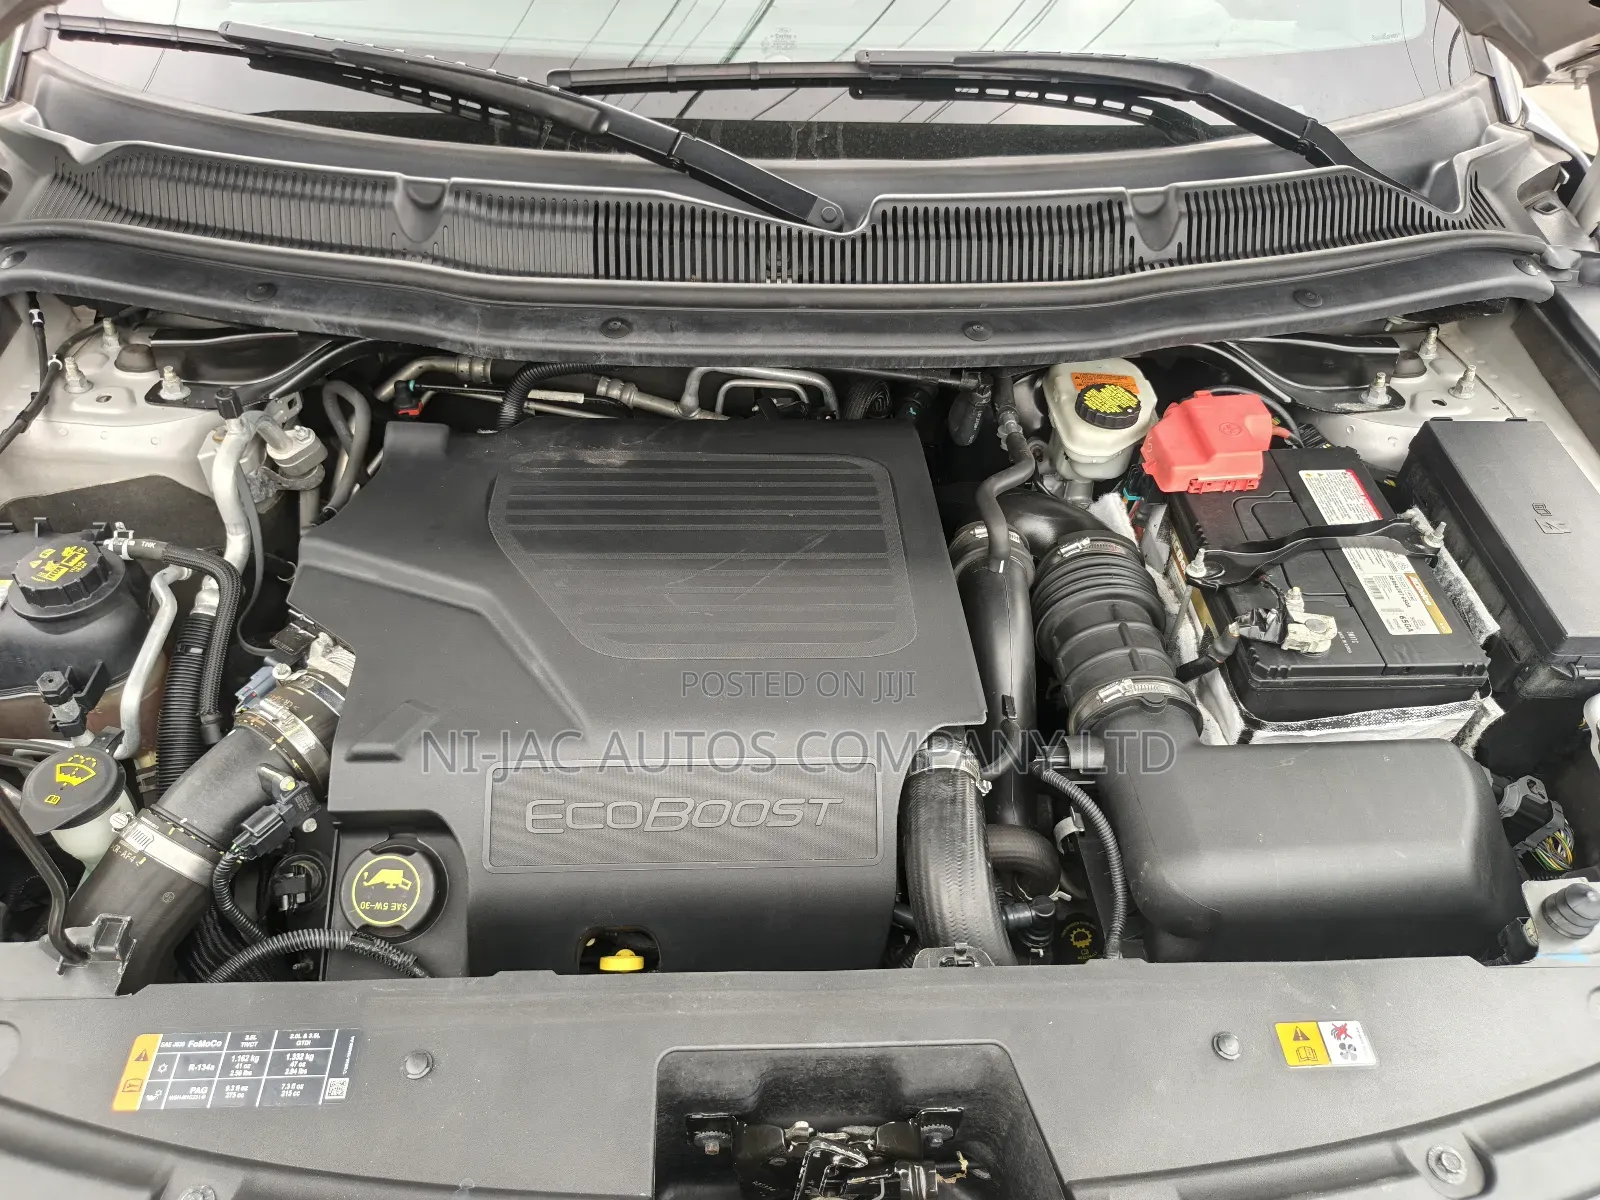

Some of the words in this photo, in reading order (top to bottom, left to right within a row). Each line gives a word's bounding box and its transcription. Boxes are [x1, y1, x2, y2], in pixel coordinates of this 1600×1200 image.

[1399, 615, 1414, 632] 65GA
[360, 901, 389, 910] 5W-30
[390, 902, 408, 911] SAE
[187, 1039, 223, 1048] FoMoCo
[250, 1054, 260, 1063] kg
[286, 1053, 304, 1061] 1.332
[304, 1052, 315, 1061] kg
[187, 1063, 215, 1071] R-134a
[189, 1086, 208, 1094] PAG
